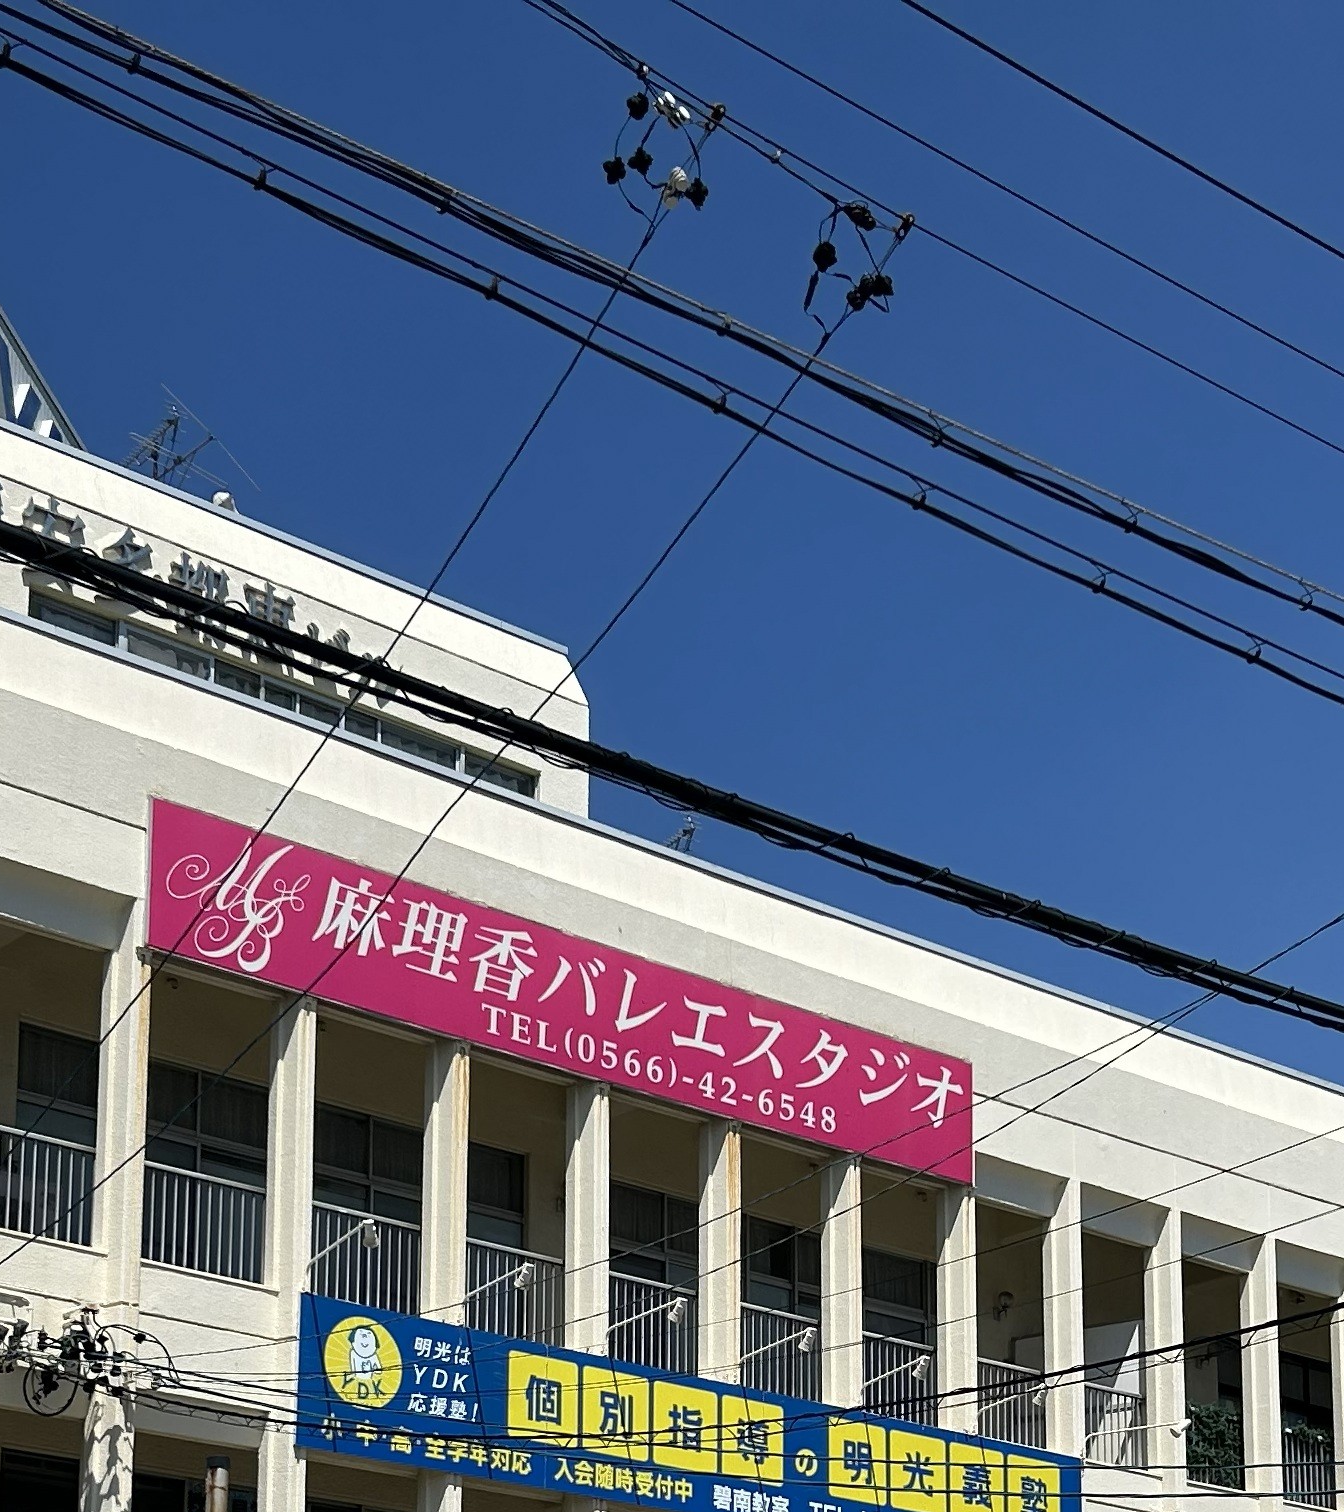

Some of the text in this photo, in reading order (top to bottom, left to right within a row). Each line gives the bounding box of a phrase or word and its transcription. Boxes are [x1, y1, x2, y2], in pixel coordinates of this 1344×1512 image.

[312, 876, 965, 1129] 麻理香バレエスタジオ
[414, 1337, 472, 1366] 明光は
[413, 1364, 471, 1394] YDK
[554, 1456, 695, 1503] 入会随時受付中
